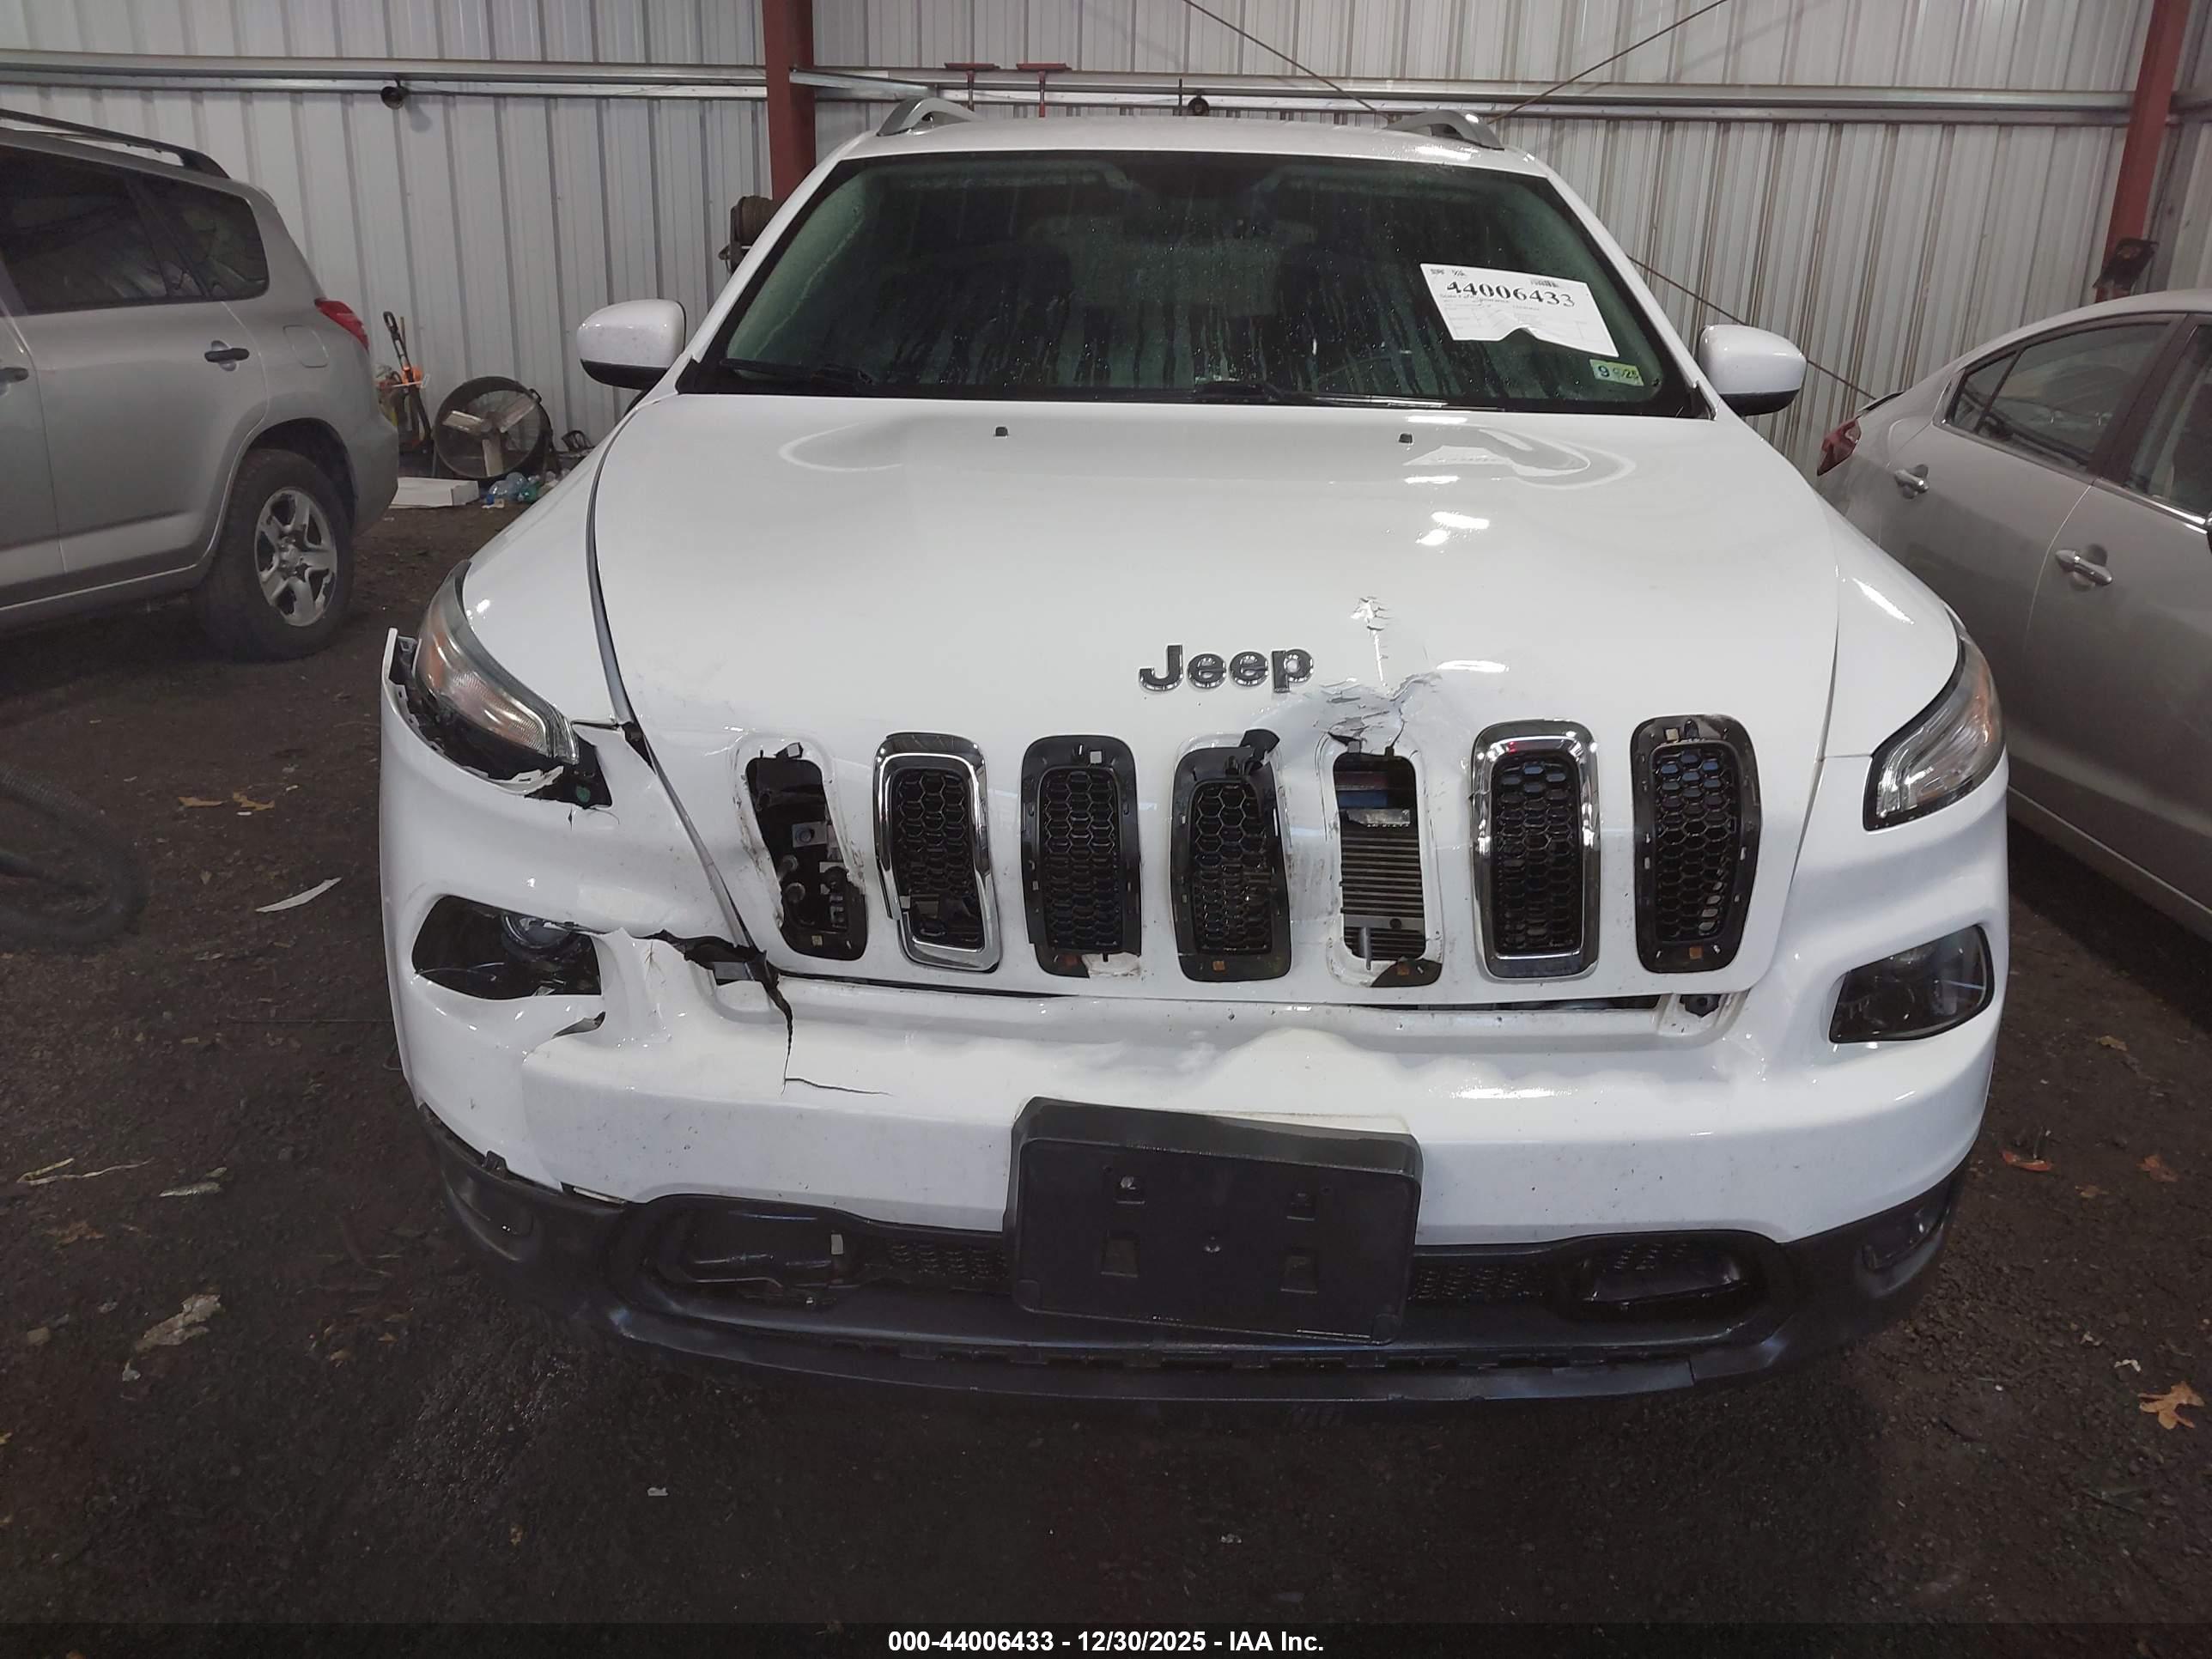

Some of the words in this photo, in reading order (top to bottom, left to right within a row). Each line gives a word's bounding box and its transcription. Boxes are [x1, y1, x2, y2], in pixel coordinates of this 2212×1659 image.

[1447, 281, 1575, 307] 44006433
[1598, 365, 1610, 377] 9
[1139, 644, 1314, 693] Jeep
